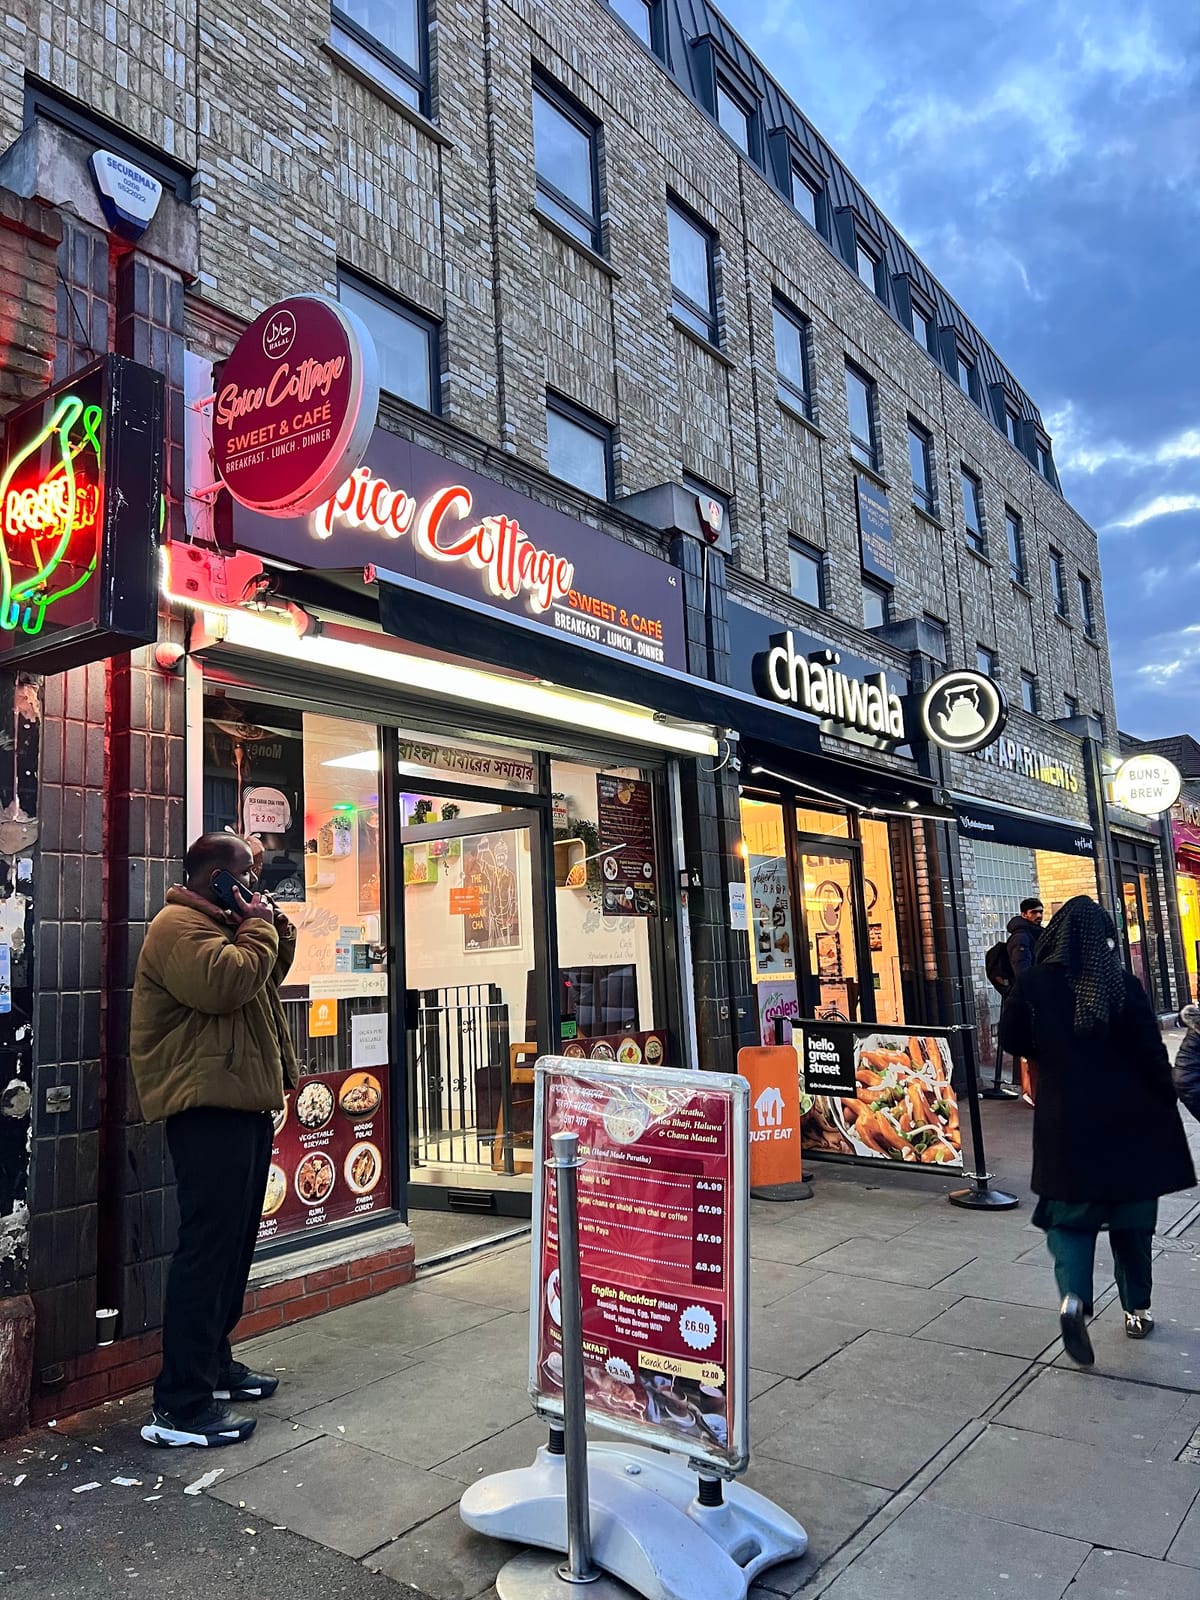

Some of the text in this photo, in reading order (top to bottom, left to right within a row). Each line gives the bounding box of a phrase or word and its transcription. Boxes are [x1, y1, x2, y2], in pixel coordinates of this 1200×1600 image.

[106, 157, 157, 193] SECUREMAX
[266, 322, 292, 343] حلال
[269, 338, 290, 350] HALAL
[216, 355, 346, 430] Spice Cottage
[227, 400, 331, 454] SWEET & CAFÉ
[225, 428, 331, 473] BREAKFAST LUNCH DINNER
[312, 465, 574, 613] pice Cottage
[568, 589, 663, 640] SWEET & CAFÉ
[554, 611, 664, 663] BREAKFAST LUNCH DINNER
[766, 630, 905, 739] chaiiwala
[493, 759, 534, 780] সমাহার
[999, 736, 1078, 793] APARTMENTS
[1129, 768, 1160, 781] BUNS
[1131, 787, 1163, 799] BREW
[471, 873, 482, 884] THE
[765, 999, 798, 1022] coolers
[808, 1037, 835, 1051] hello
[808, 1050, 840, 1063] green
[809, 1062, 840, 1075] street
[676, 1107, 705, 1118] Paratha,
[672, 1119, 692, 1130] Bhaji,
[694, 1121, 722, 1131] Haluwa
[299, 1129, 335, 1142] VEGETABLE
[659, 1129, 718, 1143] & Chana Masala
[748, 1128, 793, 1143] JUST EAT
[303, 1139, 330, 1149] BIRYANI
[610, 1150, 625, 1160] Made
[354, 1202, 374, 1212] CURRY
[634, 1206, 646, 1216] with
[668, 1212, 688, 1222] coffee
[305, 1214, 327, 1225] CURRY
[596, 1226, 609, 1237] Paya
[591, 1284, 618, 1299] English
[619, 1290, 657, 1308] Breakfast
[615, 1325, 624, 1334] Tea
[631, 1330, 649, 1340] coffee
[685, 1320, 710, 1334] £6.99
[583, 1341, 608, 1355] AKFAST
[640, 1354, 662, 1370] Karak
[701, 1370, 719, 1380] £2.00
